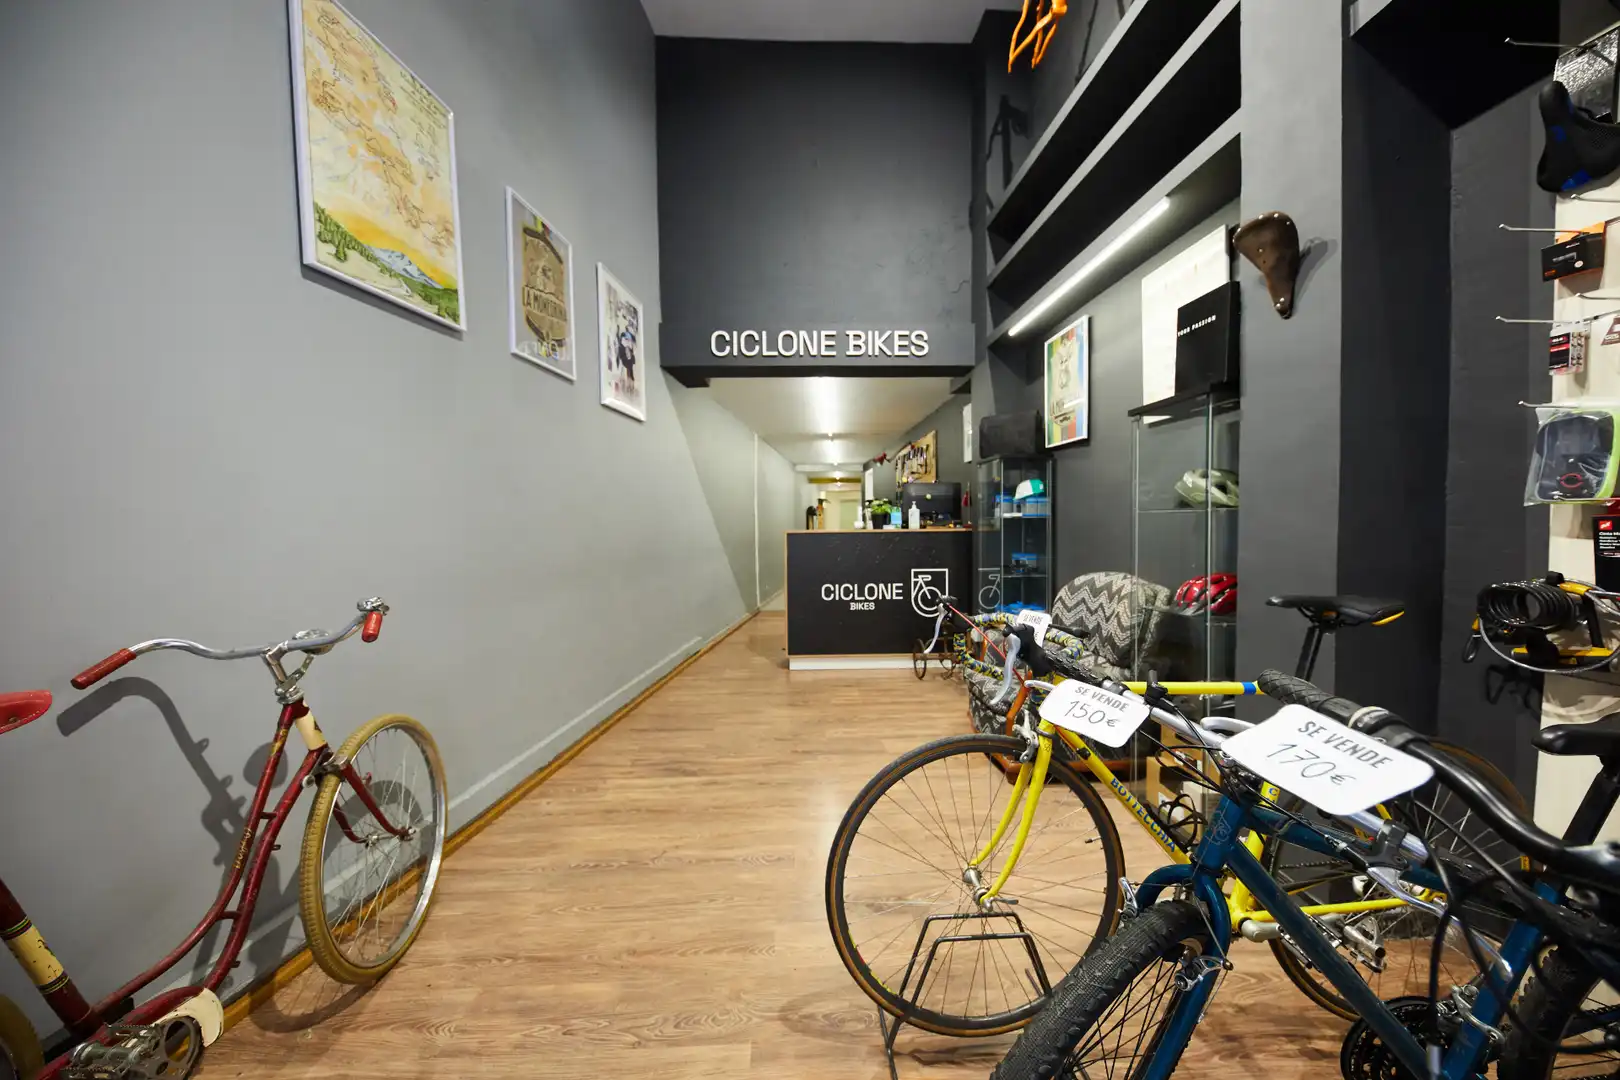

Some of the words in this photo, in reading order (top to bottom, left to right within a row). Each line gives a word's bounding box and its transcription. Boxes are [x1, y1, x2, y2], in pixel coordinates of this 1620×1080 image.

[1191, 314, 1216, 330] PASSION
[710, 330, 837, 357] CICLONE
[845, 330, 929, 357] BIKES
[821, 583, 903, 600] CICLONE
[849, 602, 875, 611] BIKES
[1074, 686, 1090, 696] SE
[1091, 691, 1129, 712] VENDE
[1064, 700, 1120, 728] 150€
[1297, 720, 1326, 738] SE
[1323, 732, 1393, 769] VENDE
[1266, 743, 1357, 786] 170€
[1110, 777, 1176, 853] BOTTECCHIA
